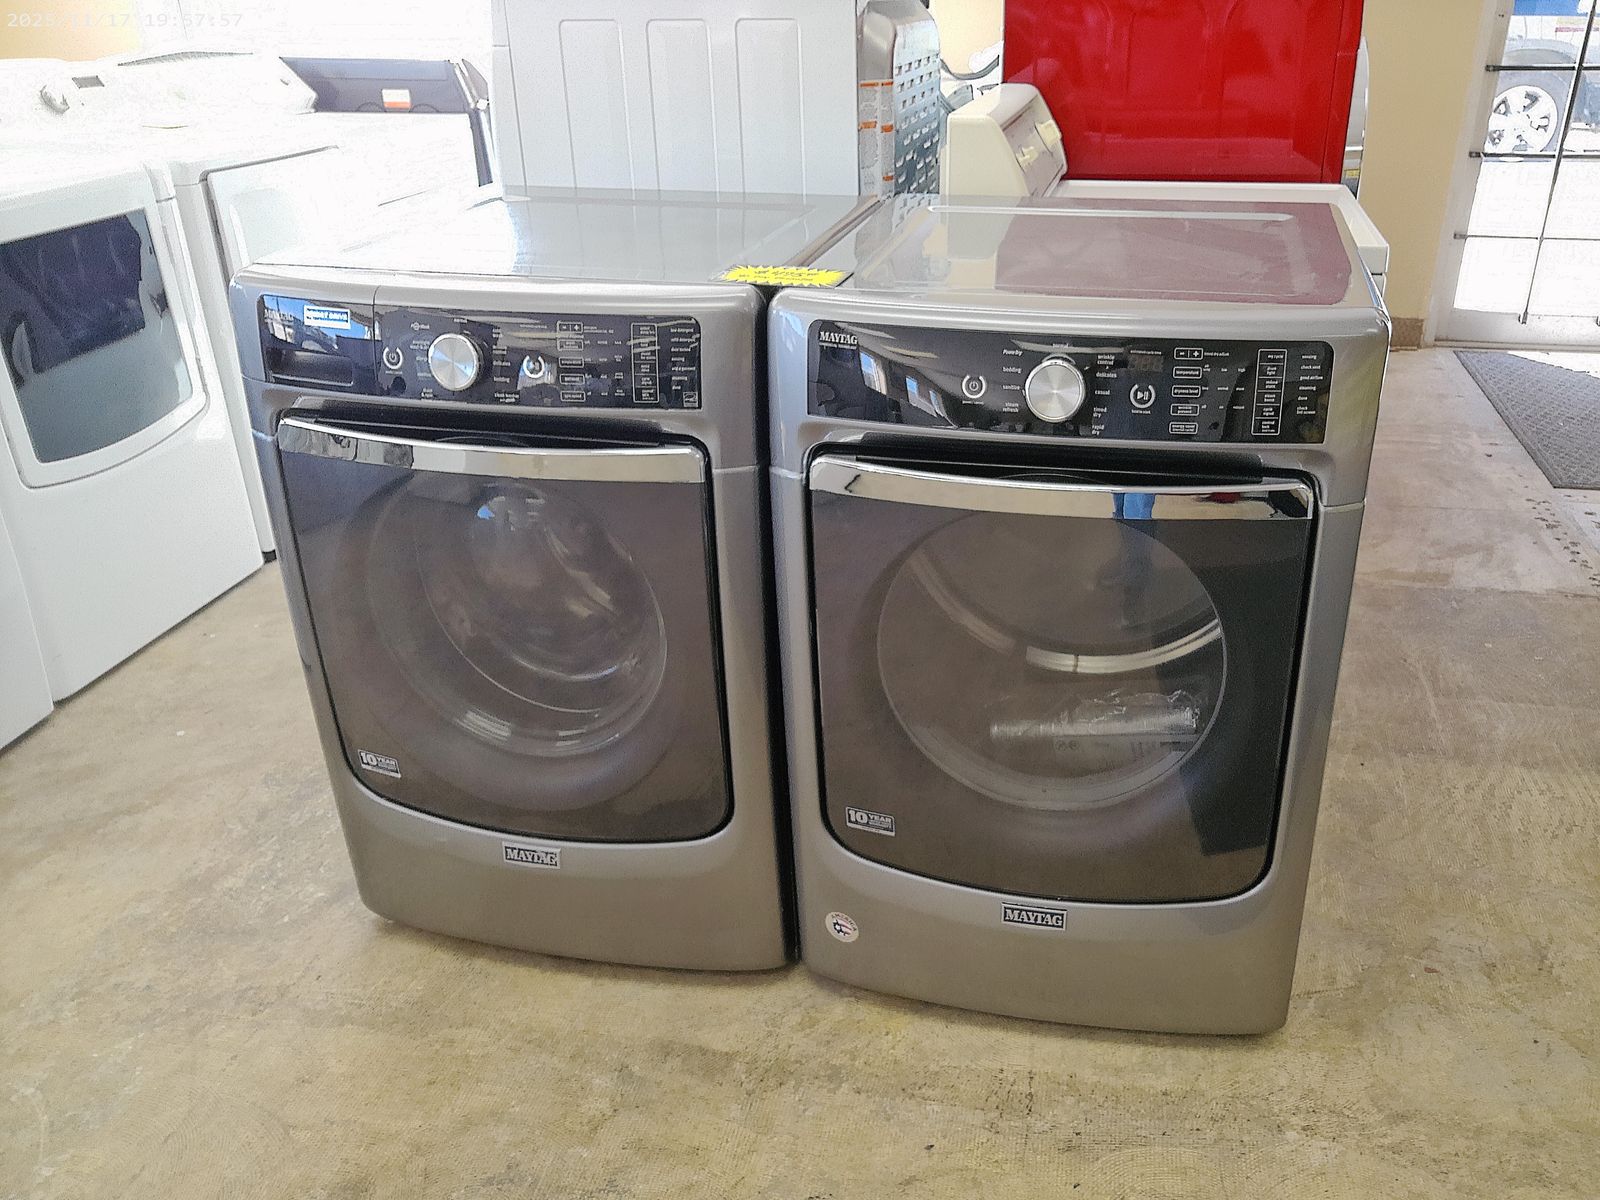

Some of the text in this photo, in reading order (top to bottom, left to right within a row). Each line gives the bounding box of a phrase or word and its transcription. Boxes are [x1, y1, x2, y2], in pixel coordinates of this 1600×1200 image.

[820, 331, 858, 345] MAYTAG
[360, 752, 378, 766] 10
[849, 810, 868, 824] 10
[506, 848, 558, 865] MAYTAG
[1004, 908, 1063, 926] MAYTAG
